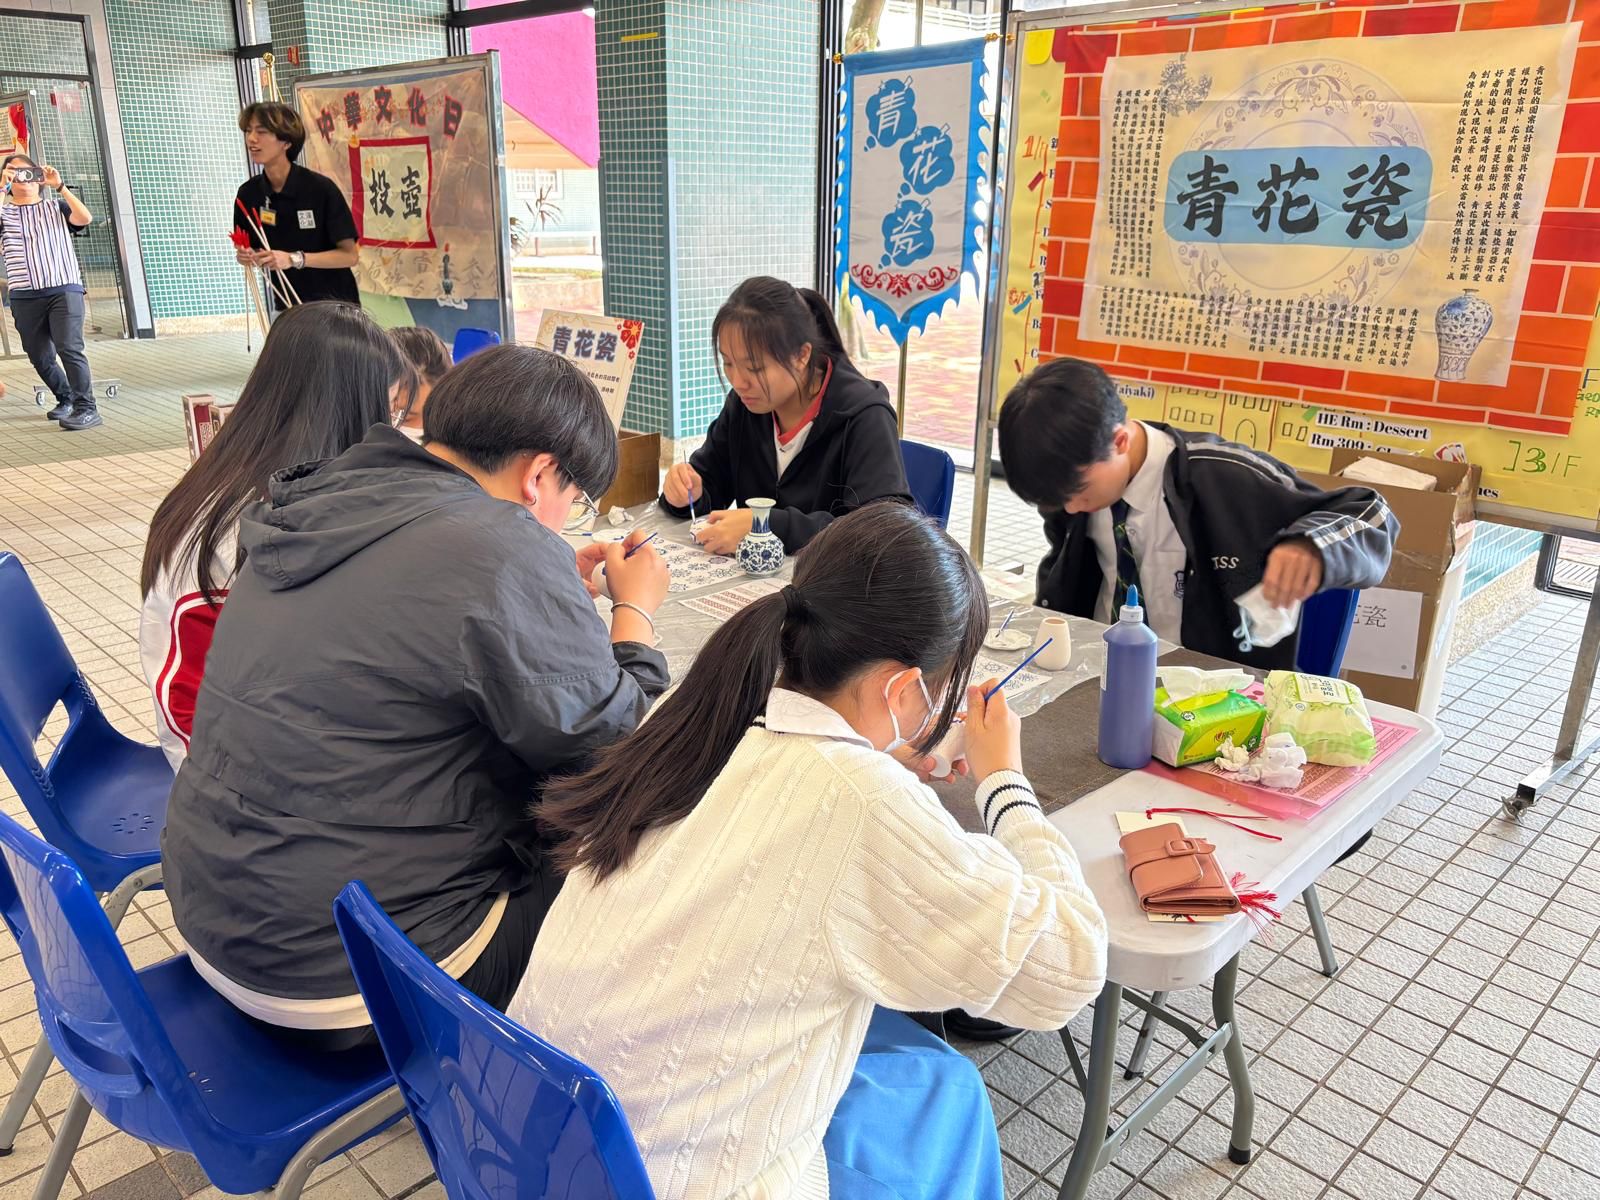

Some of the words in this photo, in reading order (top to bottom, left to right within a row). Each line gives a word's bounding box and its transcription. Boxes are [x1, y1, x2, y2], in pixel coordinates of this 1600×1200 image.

[316, 85, 464, 144] 中華文化日
[369, 166, 422, 220] 投壺
[877, 90, 945, 255] 青花瓷
[1177, 154, 1413, 240] 青花瓷
[553, 325, 618, 363] 青花瓷
[1311, 433, 1334, 448] Rm
[1317, 413, 1338, 426] HE
[1341, 415, 1364, 430] Rm
[1373, 421, 1429, 440] Dessert
